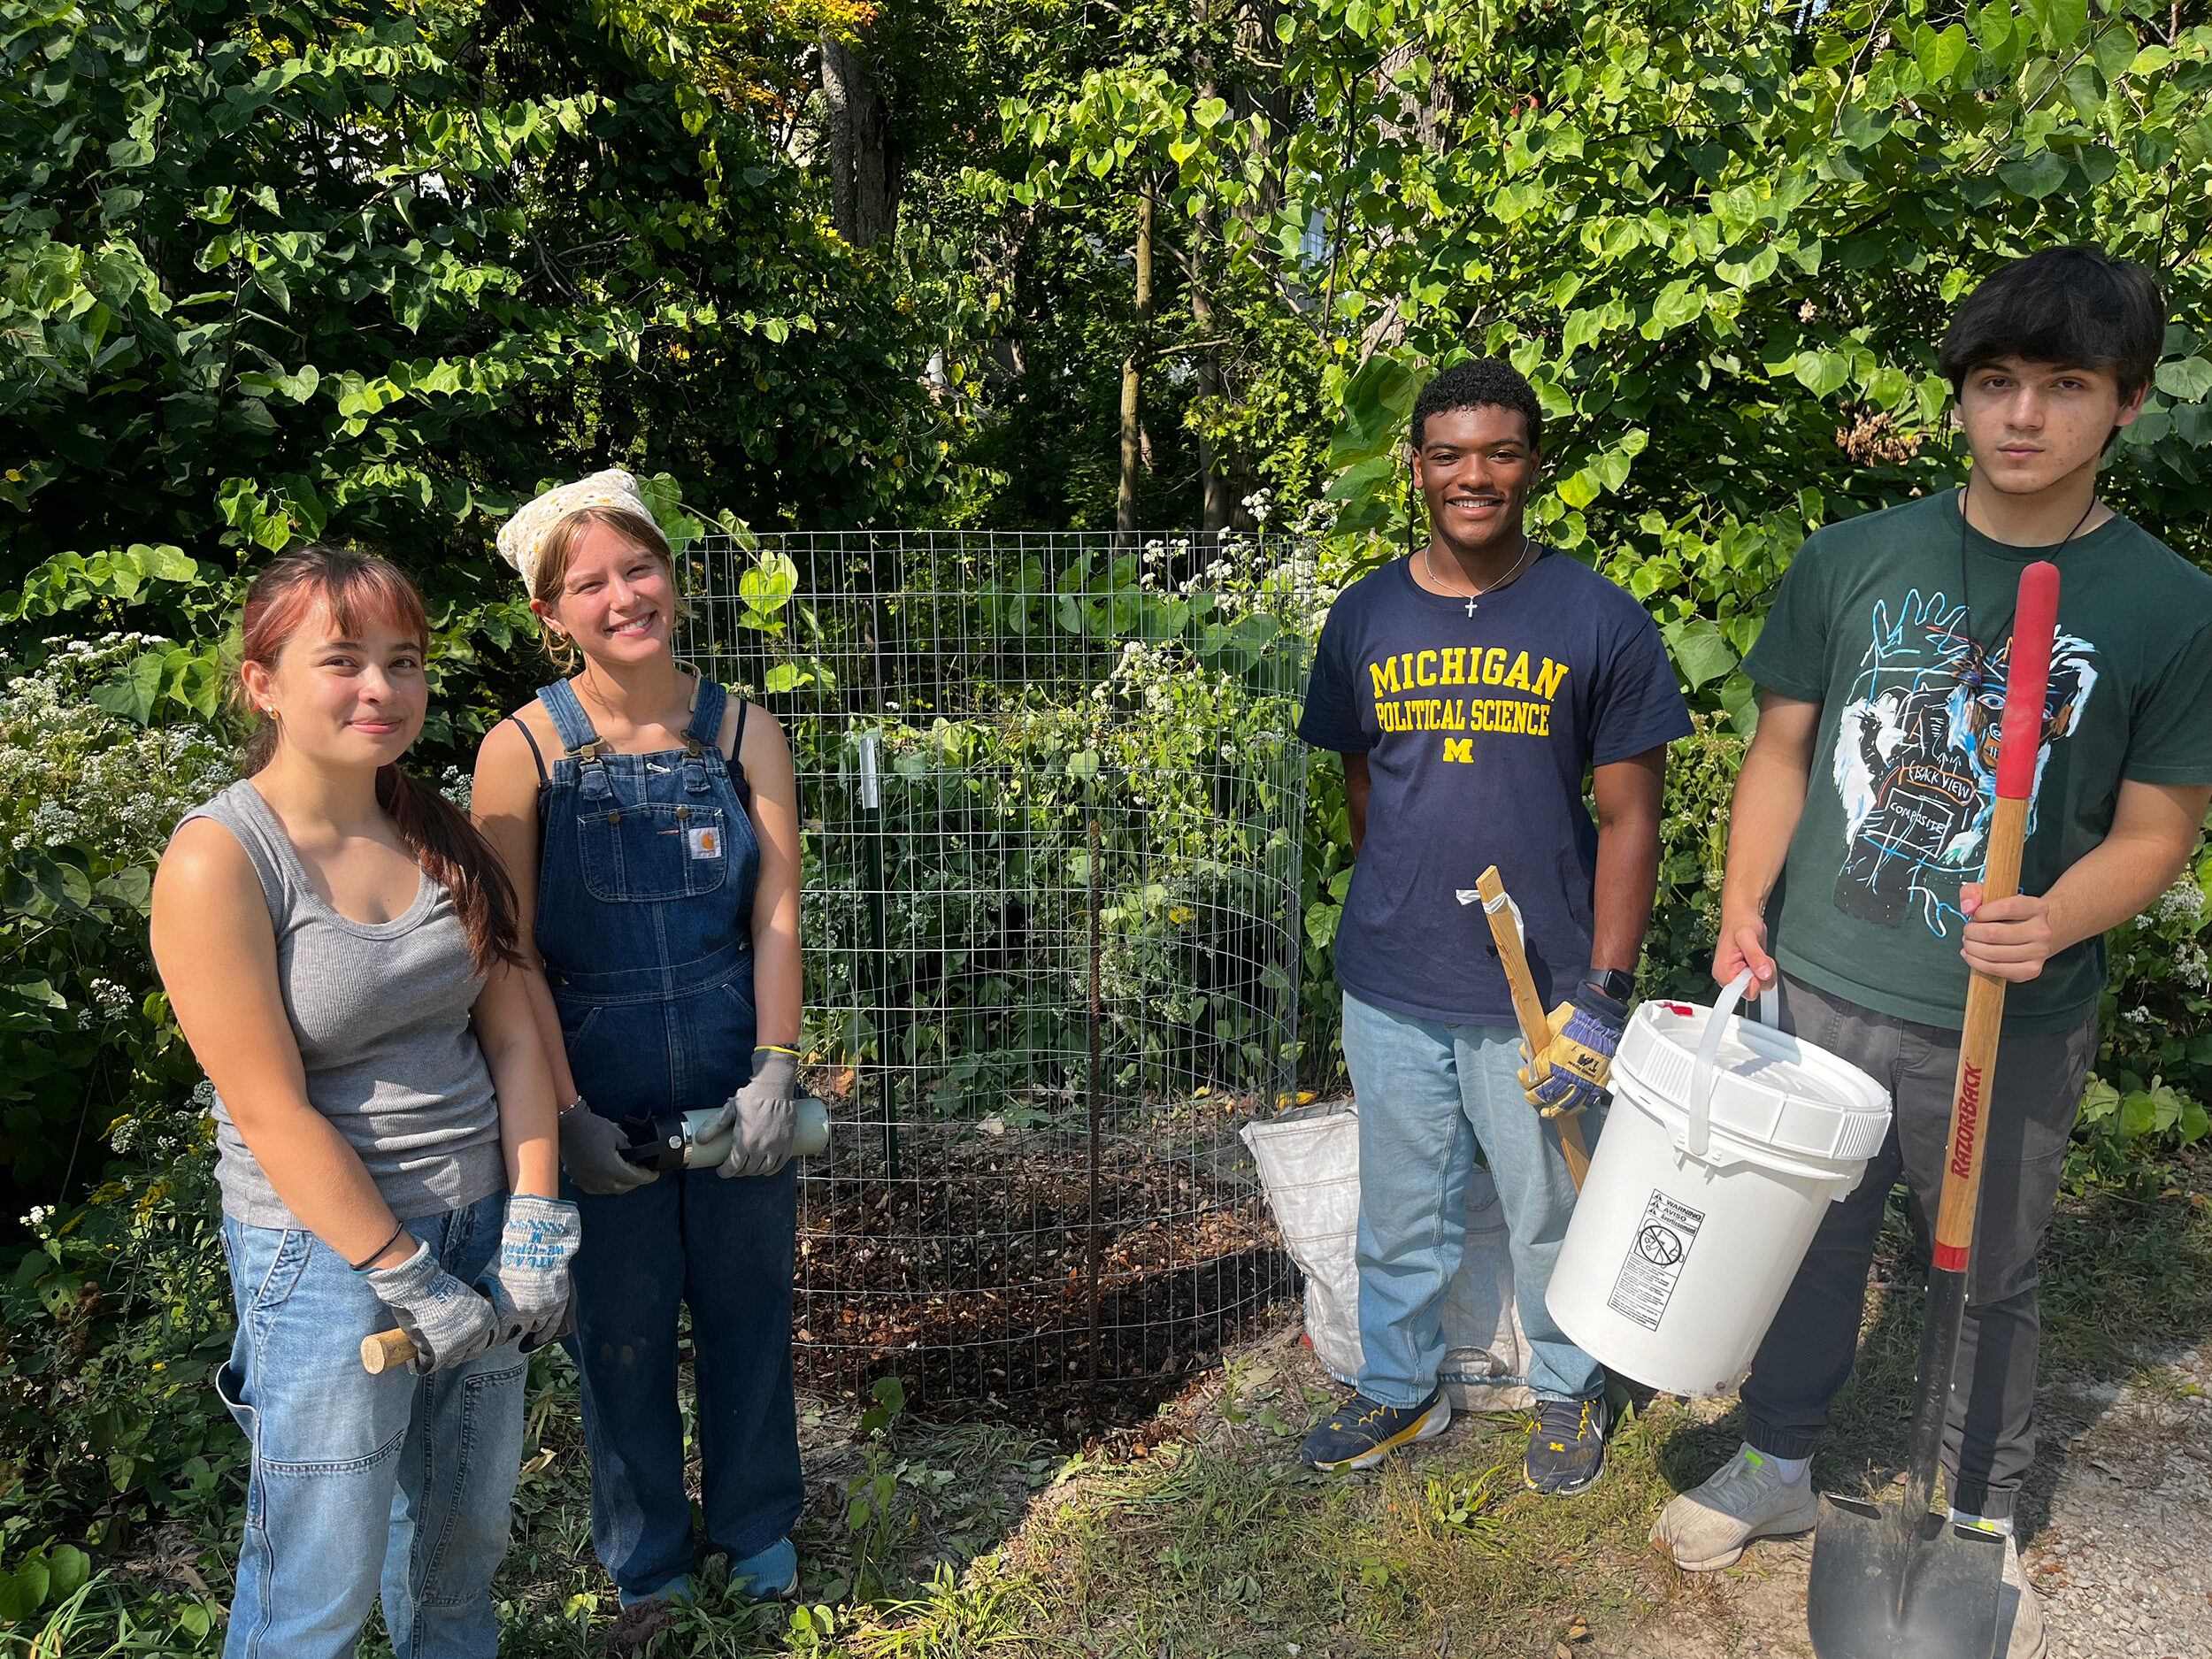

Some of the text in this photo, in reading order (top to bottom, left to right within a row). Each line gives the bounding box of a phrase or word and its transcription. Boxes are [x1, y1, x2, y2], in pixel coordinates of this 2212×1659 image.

[1369, 647, 1569, 700] MICHIGAN
[1375, 699, 1551, 736] POLITICAL SCIENCE
[1442, 737, 1474, 764] M
[1663, 1207, 1686, 1222] AVISO
[1667, 1200, 1701, 1221] WARNING
